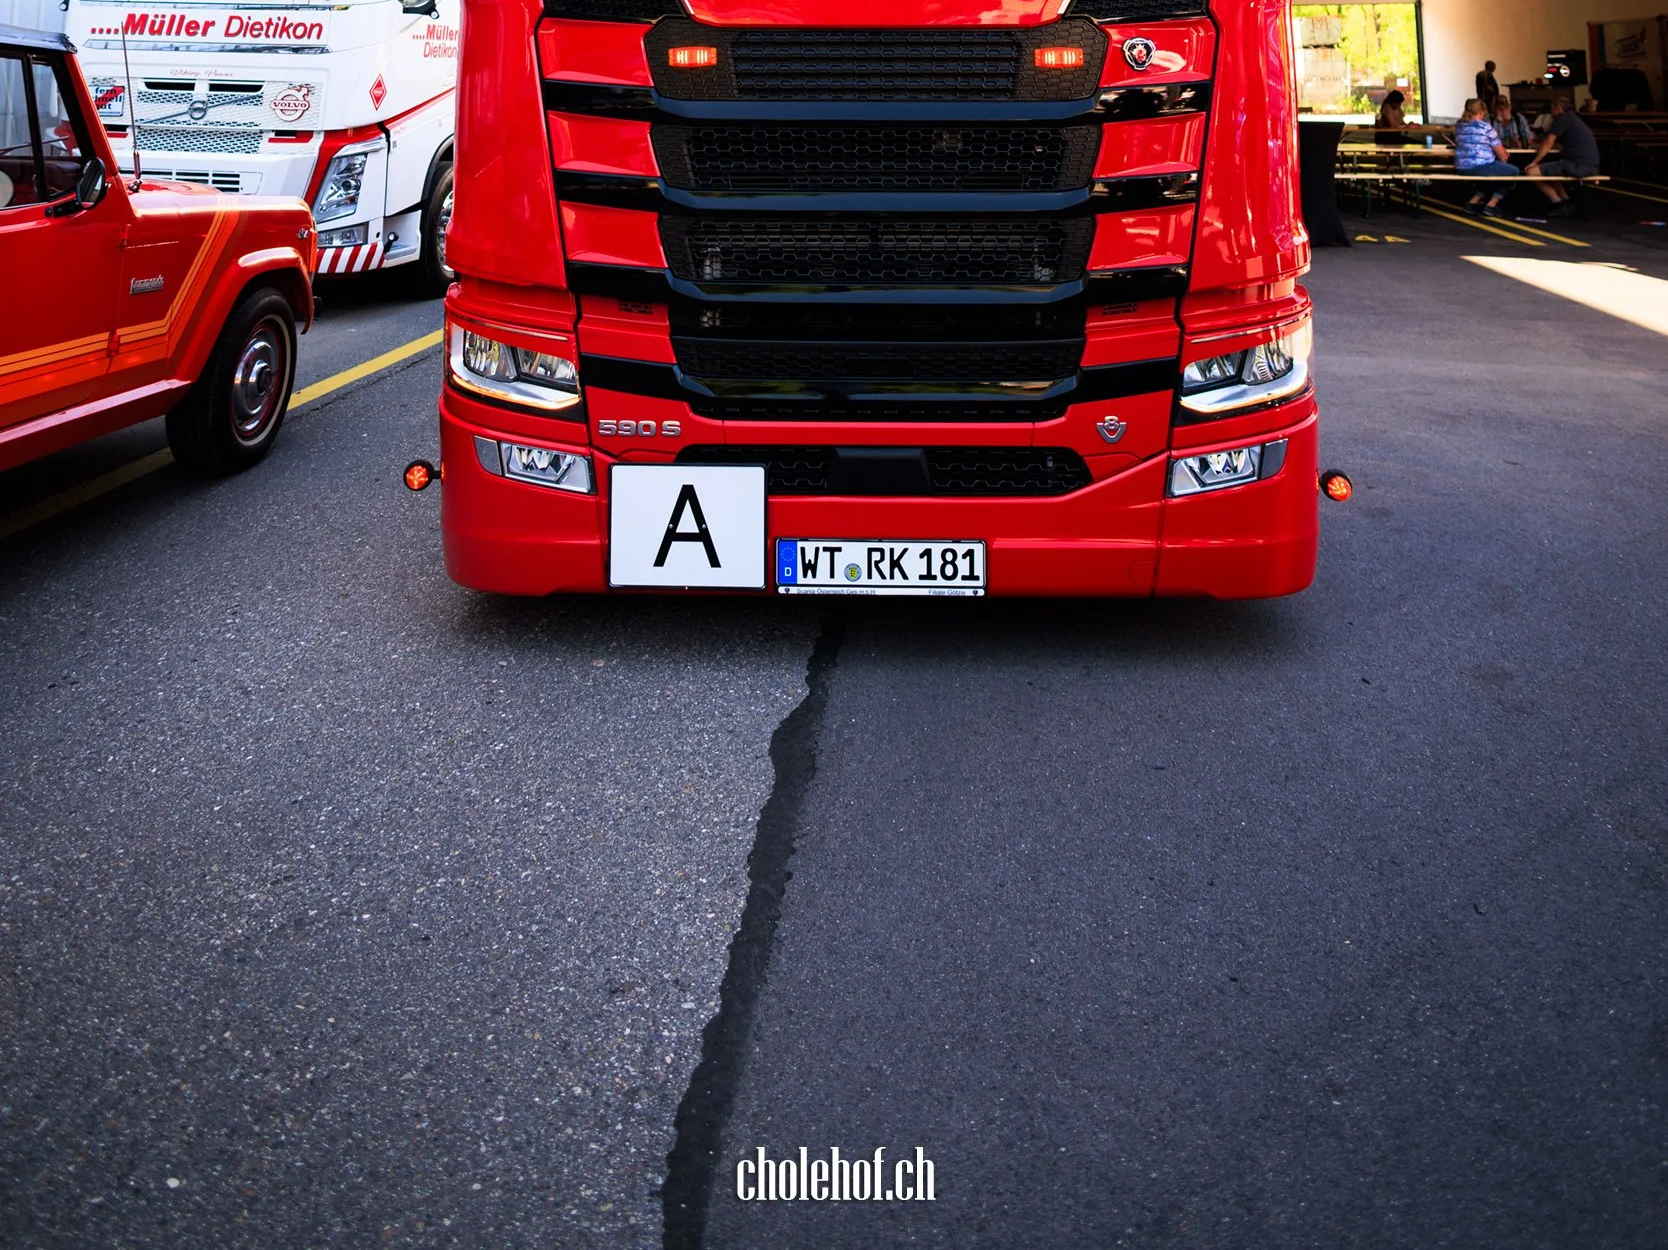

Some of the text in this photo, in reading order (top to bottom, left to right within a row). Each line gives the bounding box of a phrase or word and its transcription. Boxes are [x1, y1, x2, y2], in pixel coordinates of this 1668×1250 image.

[224, 15, 323, 40] Dietikon
[423, 42, 458, 58] Dietikon
[598, 419, 681, 437] 590 S
[653, 484, 722, 569] A
[784, 546, 980, 581] D WT RK 181
